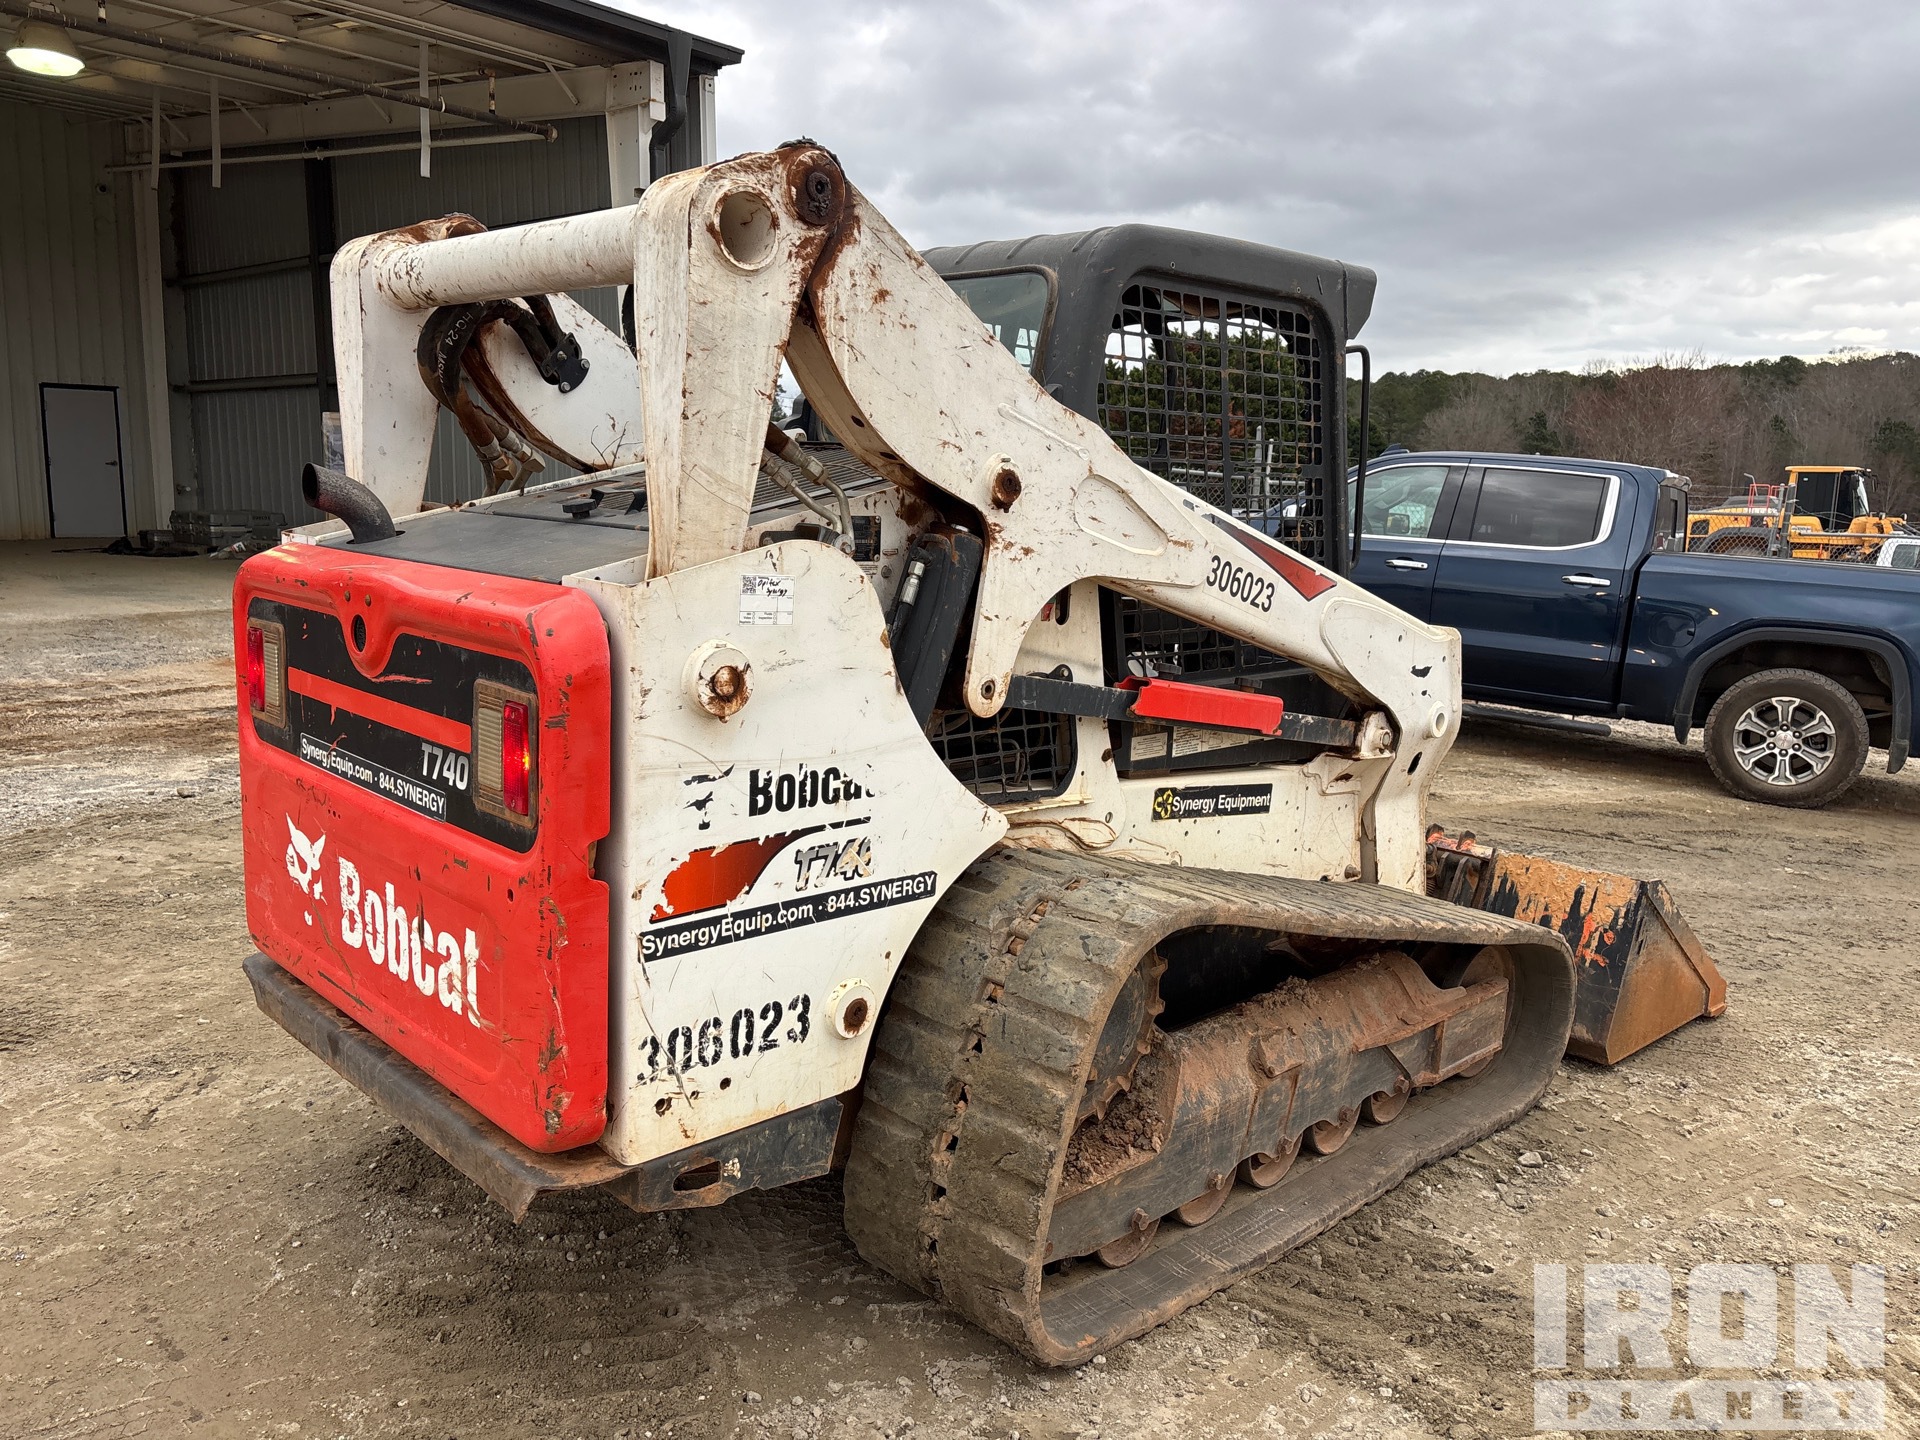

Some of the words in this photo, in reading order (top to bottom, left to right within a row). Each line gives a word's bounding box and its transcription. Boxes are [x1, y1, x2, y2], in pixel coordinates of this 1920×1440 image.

[1206, 555, 1275, 613] 306023
[302, 738, 373, 784] SynergyEquip.com
[379, 772, 445, 814] 844.SYNERGY
[422, 742, 470, 790] T740
[1172, 796, 1217, 814] Synergy
[1217, 793, 1271, 811] Equipment
[338, 856, 482, 1028] Bobcat
[642, 902, 814, 957] SynergyEquip.com
[827, 874, 936, 913] 844.SYNERGY
[637, 993, 811, 1085] 306023
